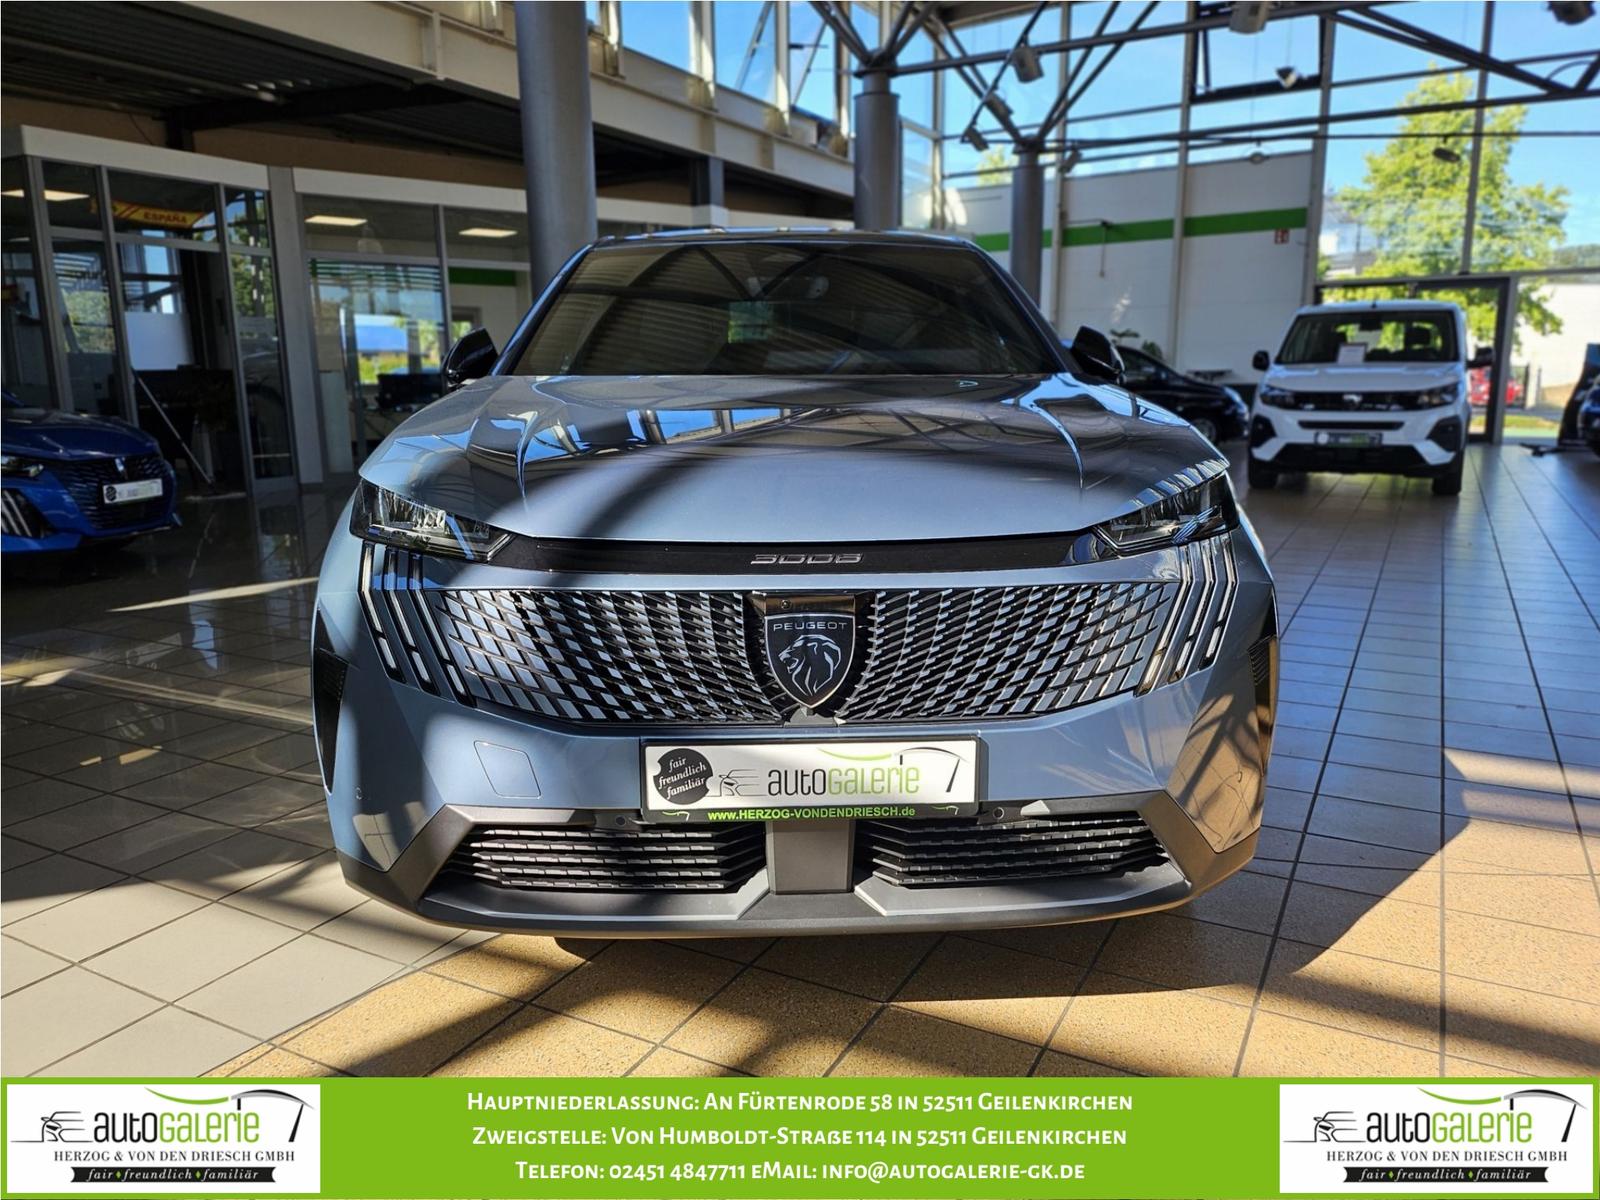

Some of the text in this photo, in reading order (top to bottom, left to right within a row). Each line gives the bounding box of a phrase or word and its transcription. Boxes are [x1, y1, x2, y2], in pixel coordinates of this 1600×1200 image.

[143, 211, 187, 224] ESPAÑA
[750, 553, 863, 565] 3008
[773, 621, 848, 632] PEUGEOT
[669, 757, 687, 773] fair
[658, 762, 707, 790] freundlich
[667, 777, 705, 800] familiär
[707, 806, 916, 820] www.HERZOG-VONDENDRIESCH.de
